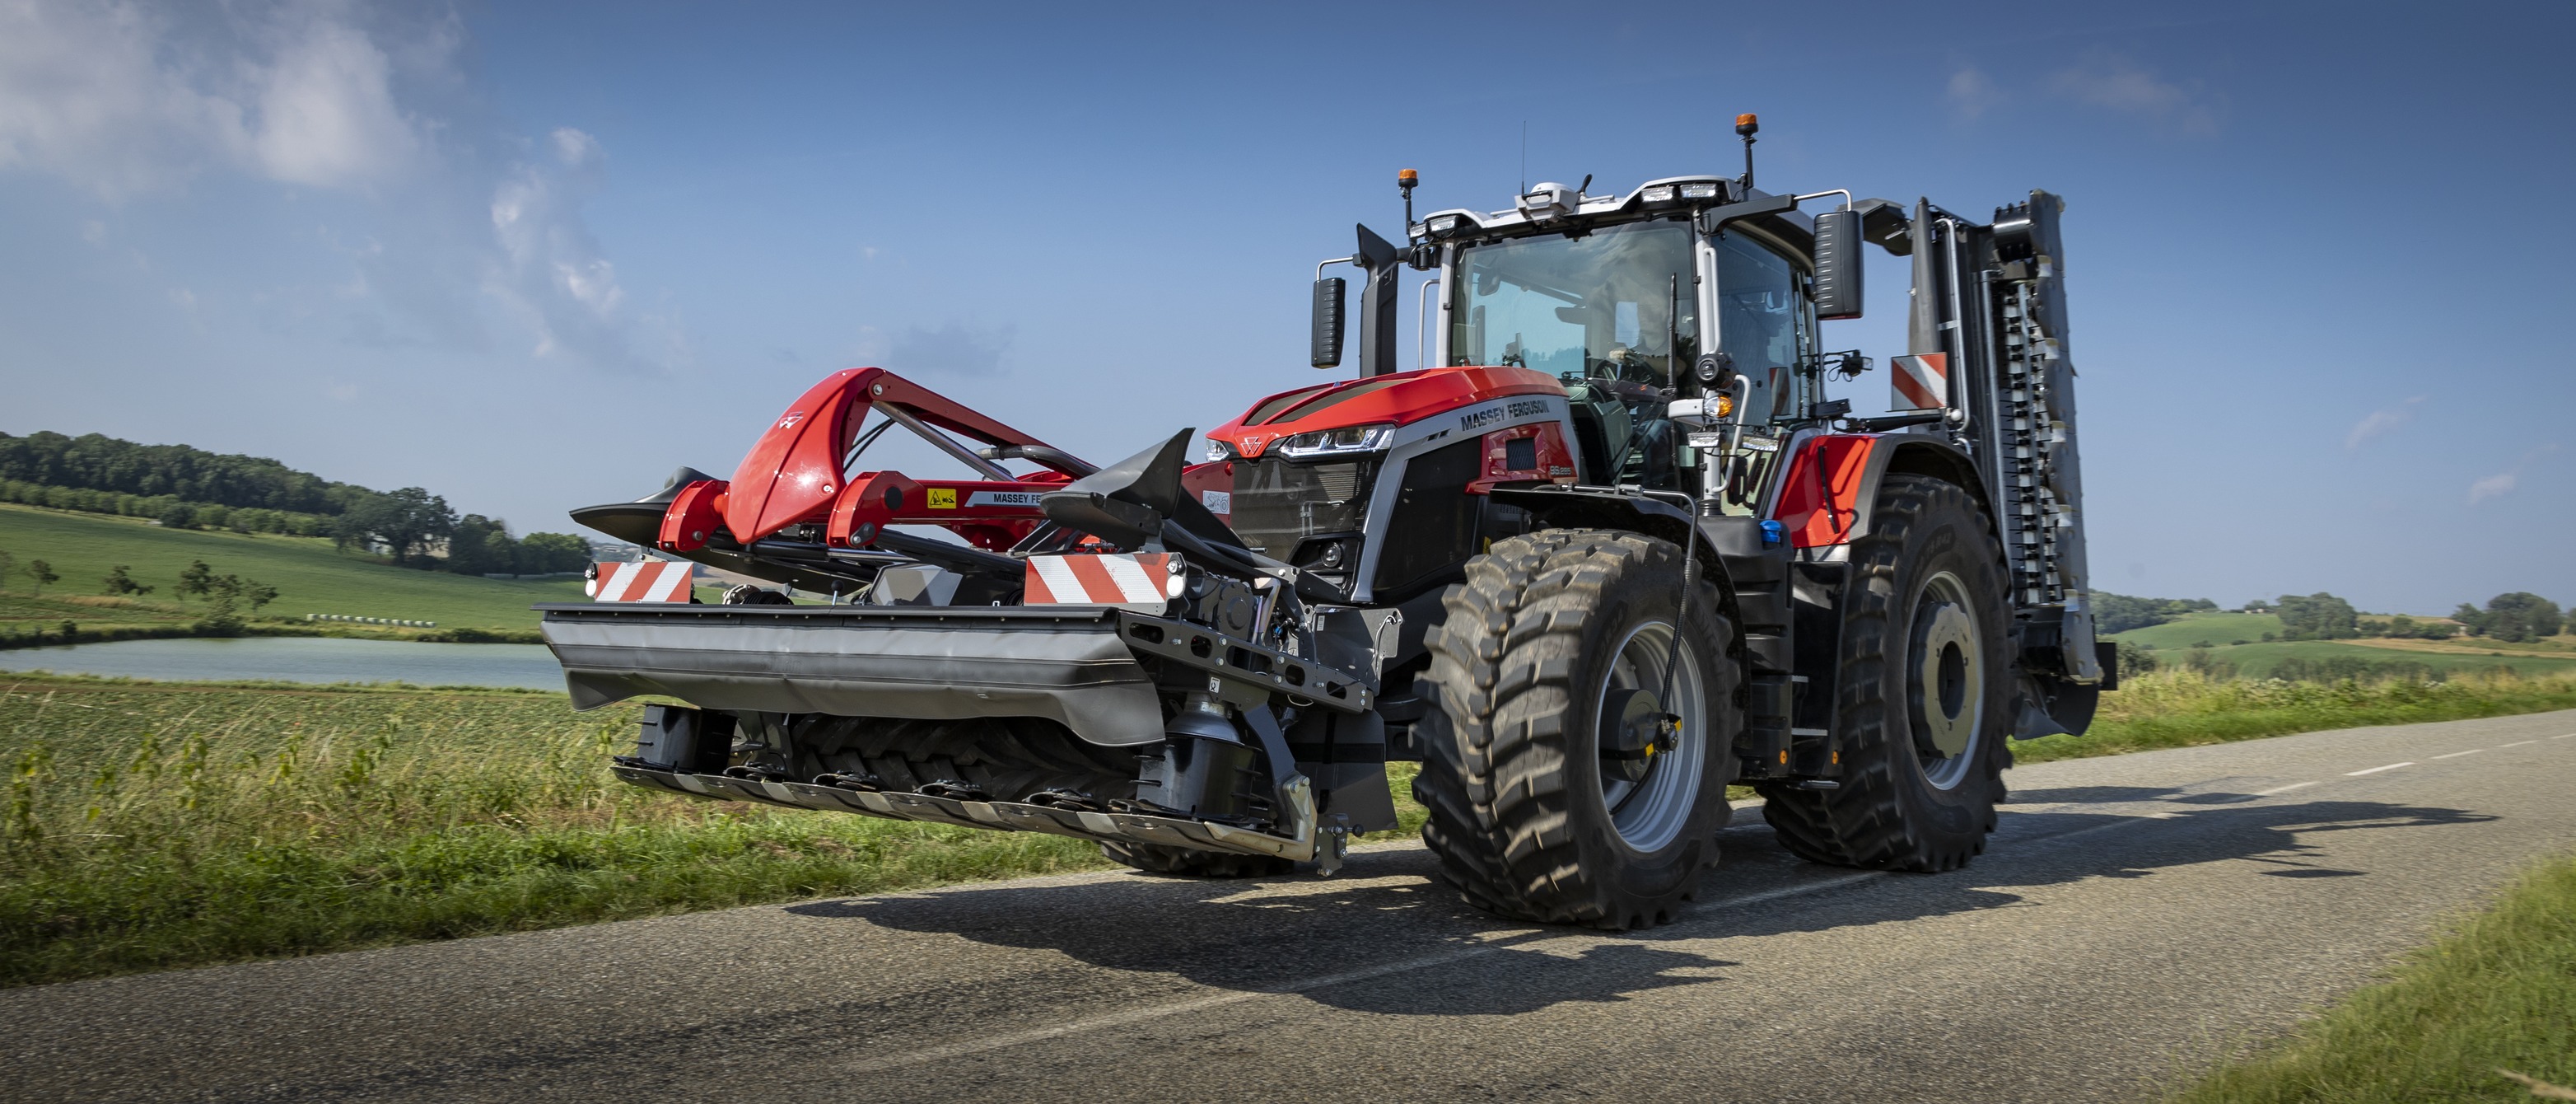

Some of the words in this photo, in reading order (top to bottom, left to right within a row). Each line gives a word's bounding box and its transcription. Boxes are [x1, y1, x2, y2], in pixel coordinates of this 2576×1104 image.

[1460, 406, 1505, 432] MASSEY
[1507, 400, 1550, 419] FERGUSON
[993, 494, 1029, 503] MASSEY
[1031, 494, 1042, 503] FE
